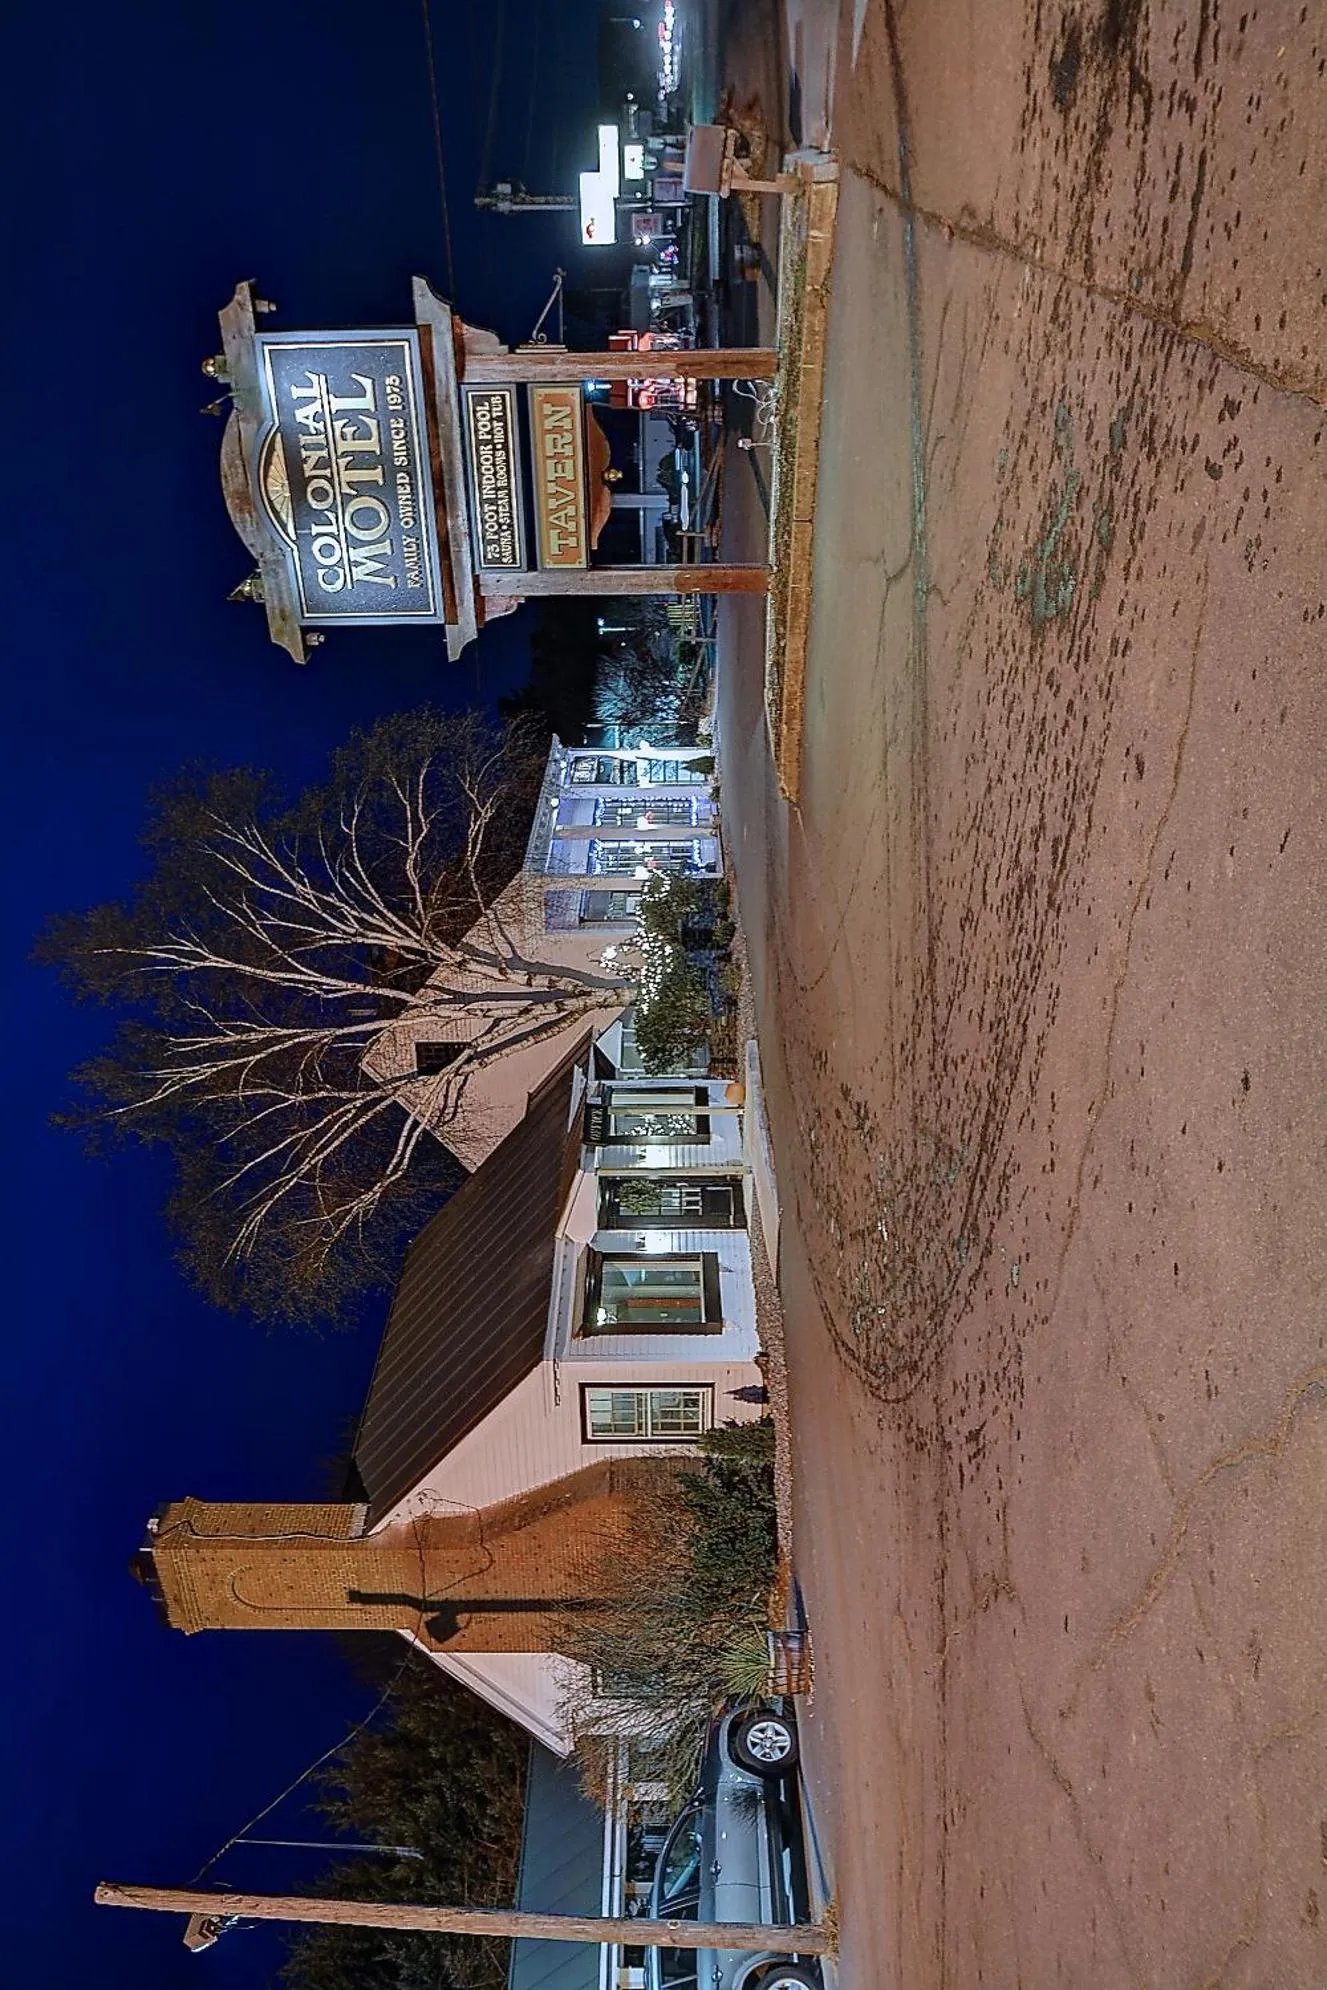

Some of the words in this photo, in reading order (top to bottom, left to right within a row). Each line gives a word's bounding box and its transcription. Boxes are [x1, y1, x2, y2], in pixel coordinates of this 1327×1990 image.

[385, 374, 403, 411] 1975
[490, 395, 503, 418] TUB
[475, 401, 493, 440] POOL
[492, 420, 504, 443] HOT
[389, 417, 408, 466] SINCE
[291, 371, 346, 593] COLONIAL
[329, 373, 397, 589] MOTEL
[478, 444, 497, 498] INDOOR
[495, 450, 508, 486] ROOMS
[543, 401, 578, 556] TAVERN
[395, 472, 414, 529] OWNED
[497, 489, 511, 524] STEAM
[484, 503, 499, 540] FOOT
[401, 534, 422, 588] FAMILY
[501, 530, 513, 564] SAUNA
